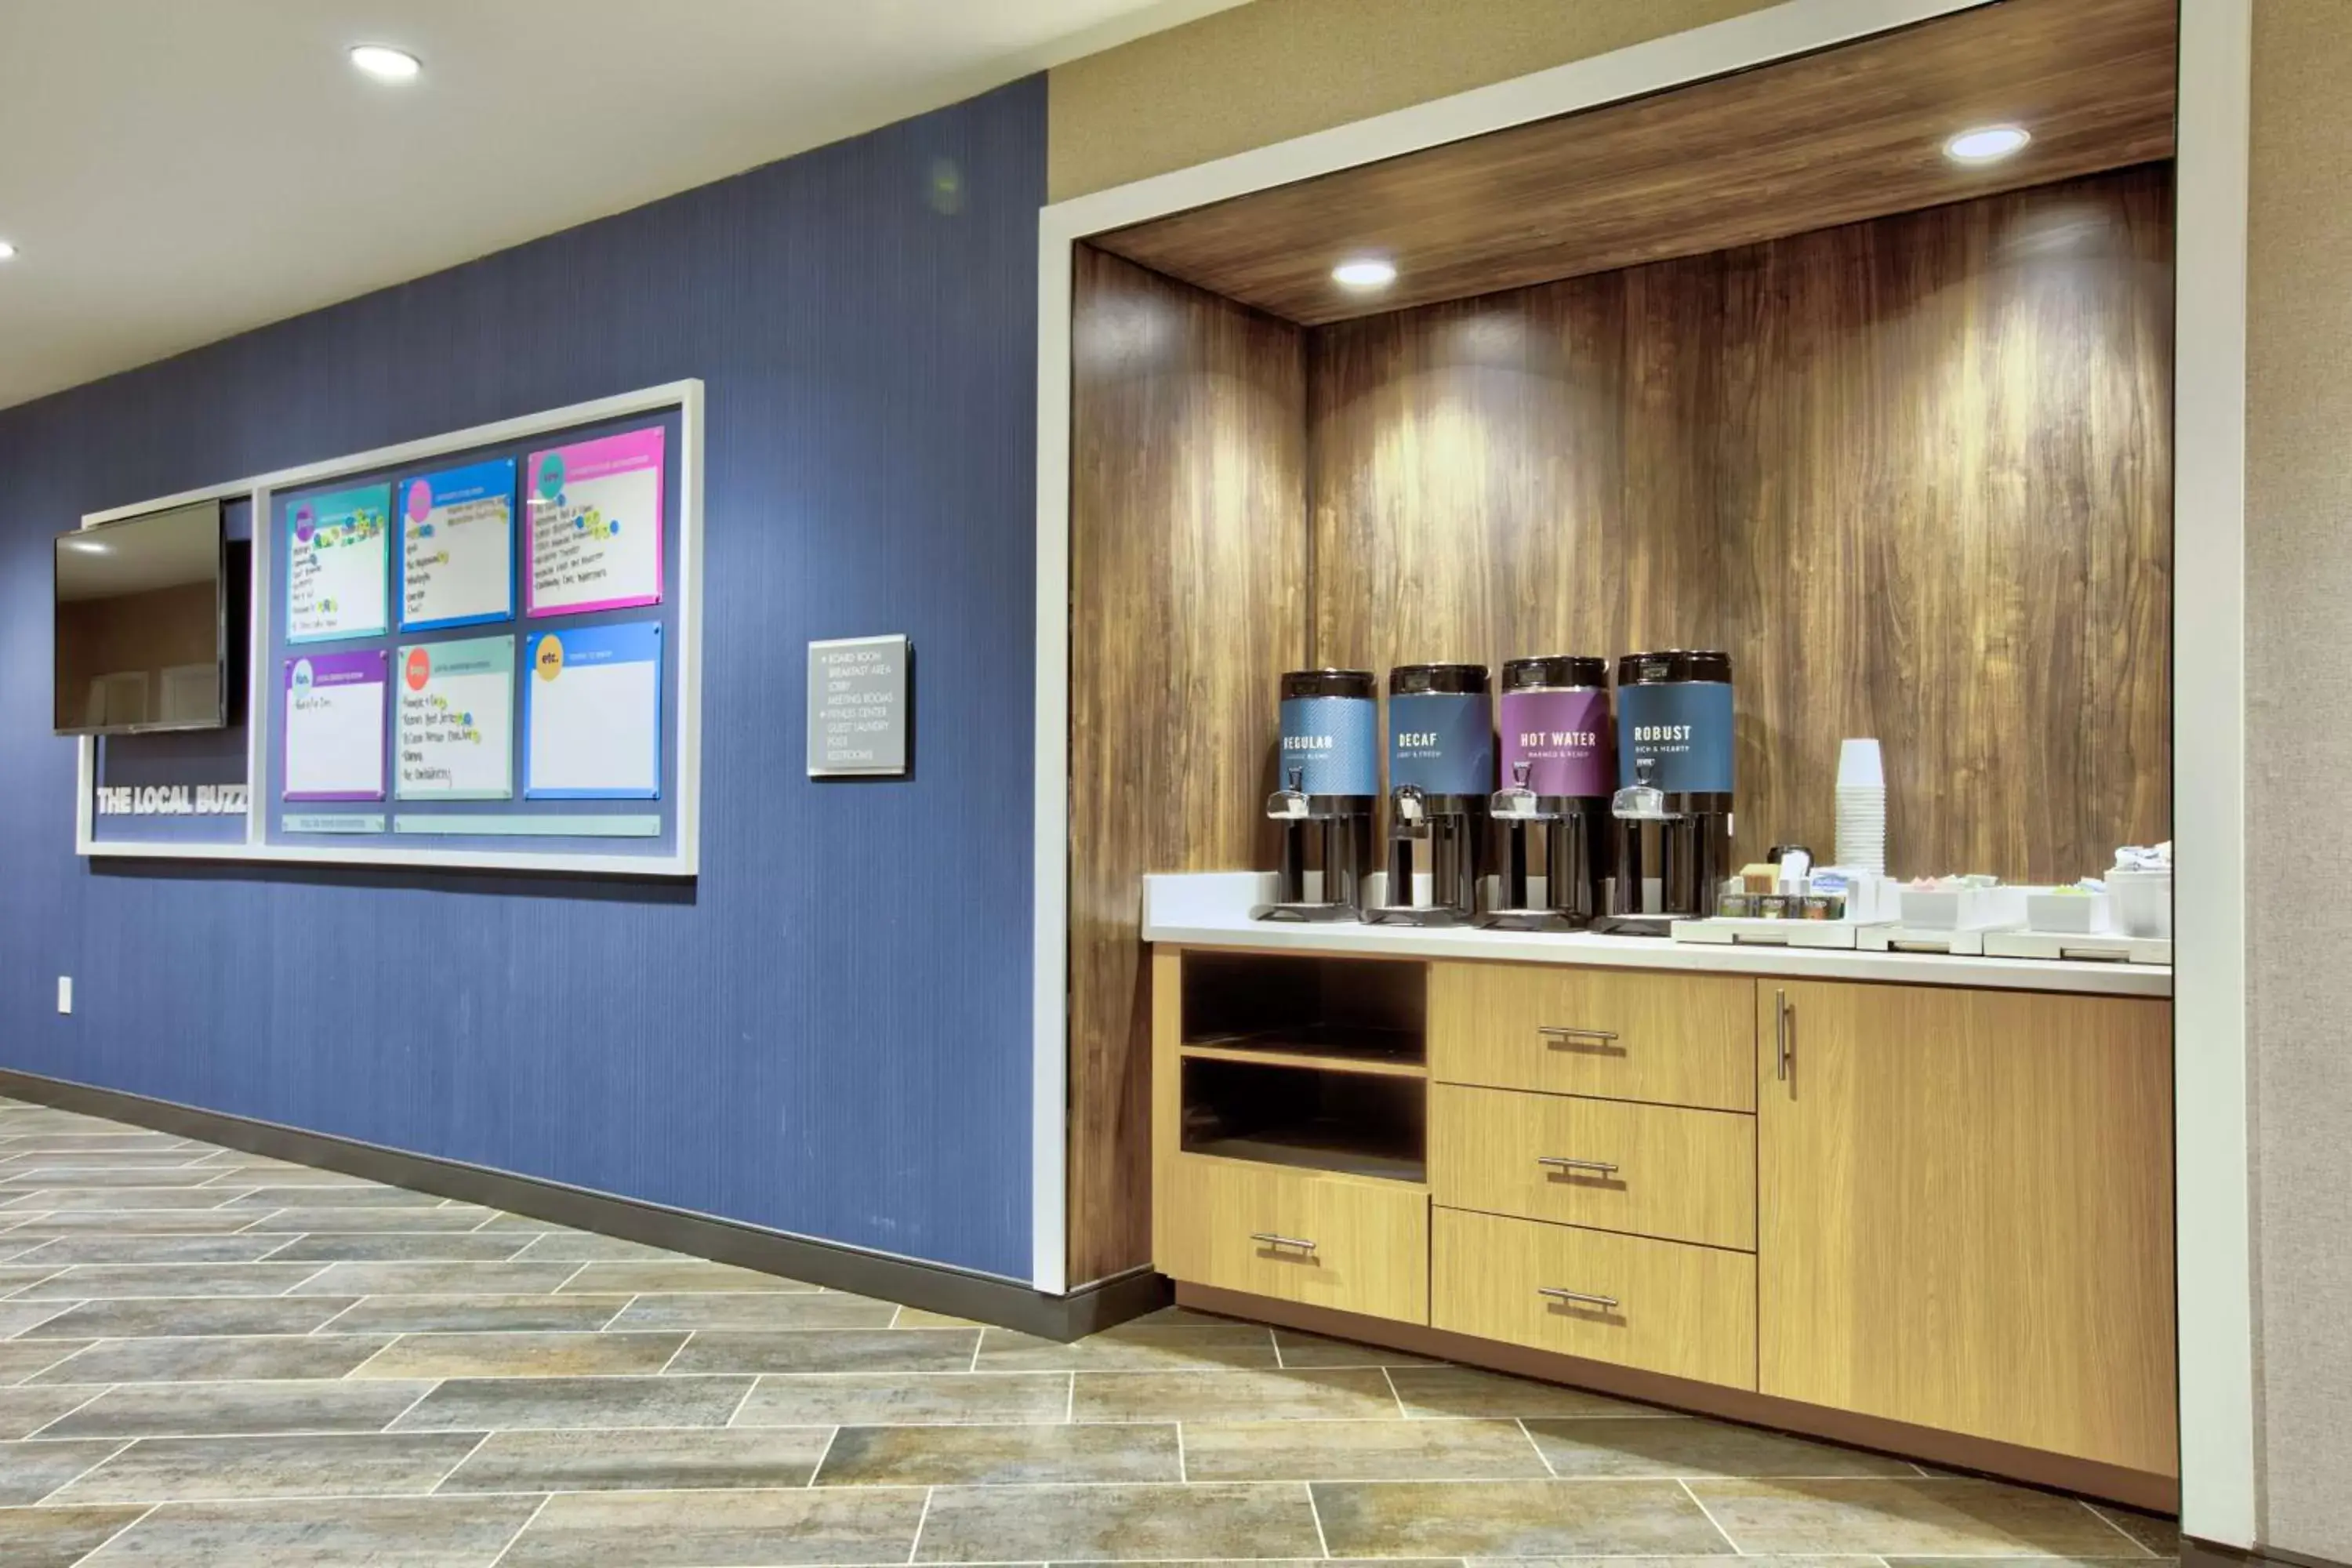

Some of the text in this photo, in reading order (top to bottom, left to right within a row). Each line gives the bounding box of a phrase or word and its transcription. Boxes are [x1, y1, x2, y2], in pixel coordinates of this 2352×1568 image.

[542, 652, 559, 664] etc.
[1399, 733, 1437, 747] DECAF
[1521, 731, 1596, 746] HOT WATER
[1635, 725, 1692, 741] ROBUST
[1283, 735, 1333, 750] REGULAR
[97, 784, 248, 814] THE LOCAL BUZZ
